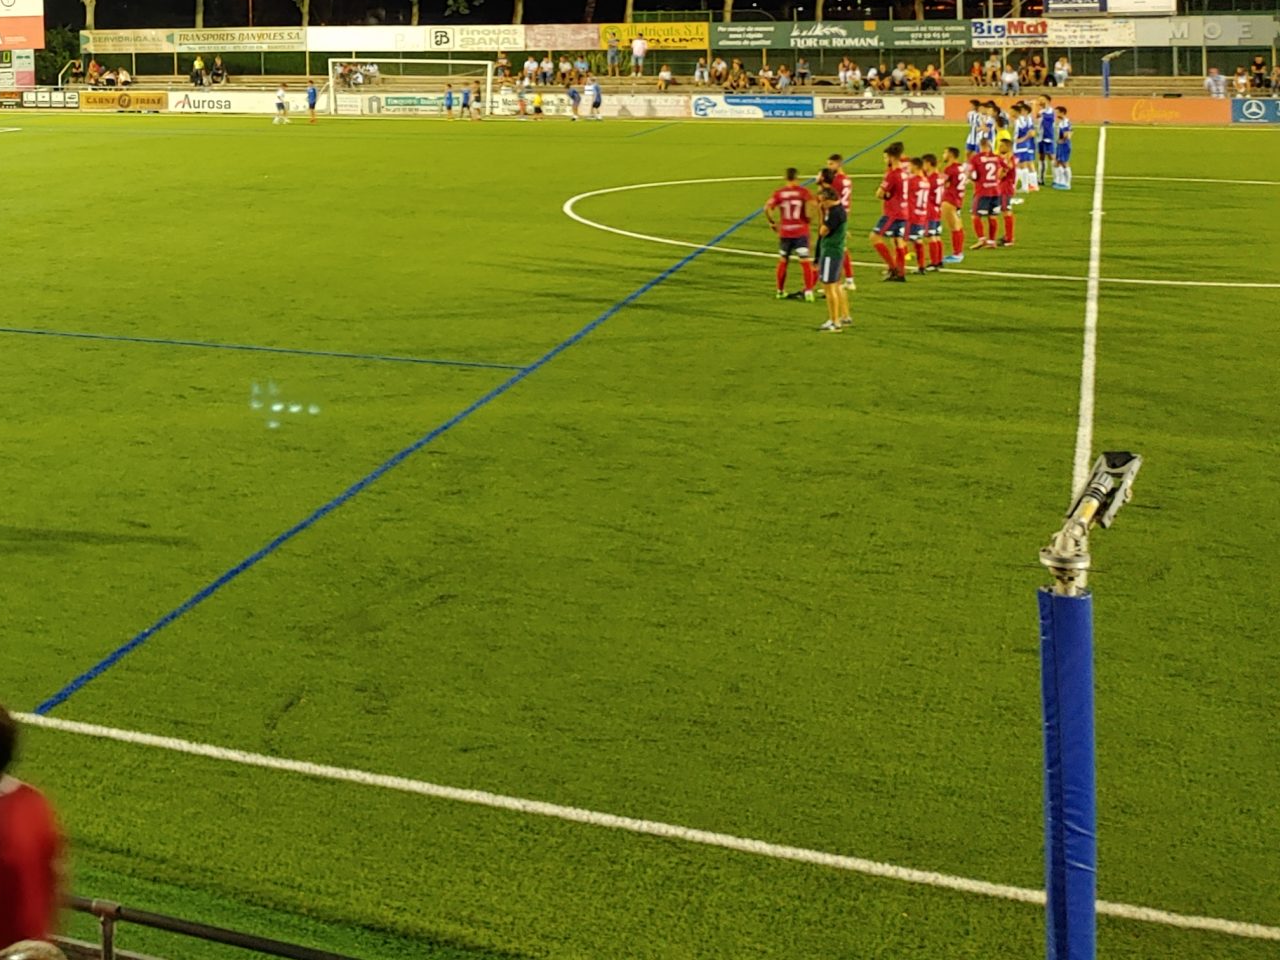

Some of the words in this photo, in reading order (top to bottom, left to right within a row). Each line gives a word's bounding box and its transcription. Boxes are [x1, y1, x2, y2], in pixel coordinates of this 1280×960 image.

[179, 33, 236, 41] TRANSPORTS
[238, 32, 284, 41] BANYOLES
[972, 20, 1048, 38] BigMat
[790, 37, 817, 48] FLOR
[175, 94, 231, 109] Aurosa
[986, 164, 997, 181] 2
[781, 200, 802, 219] 17
